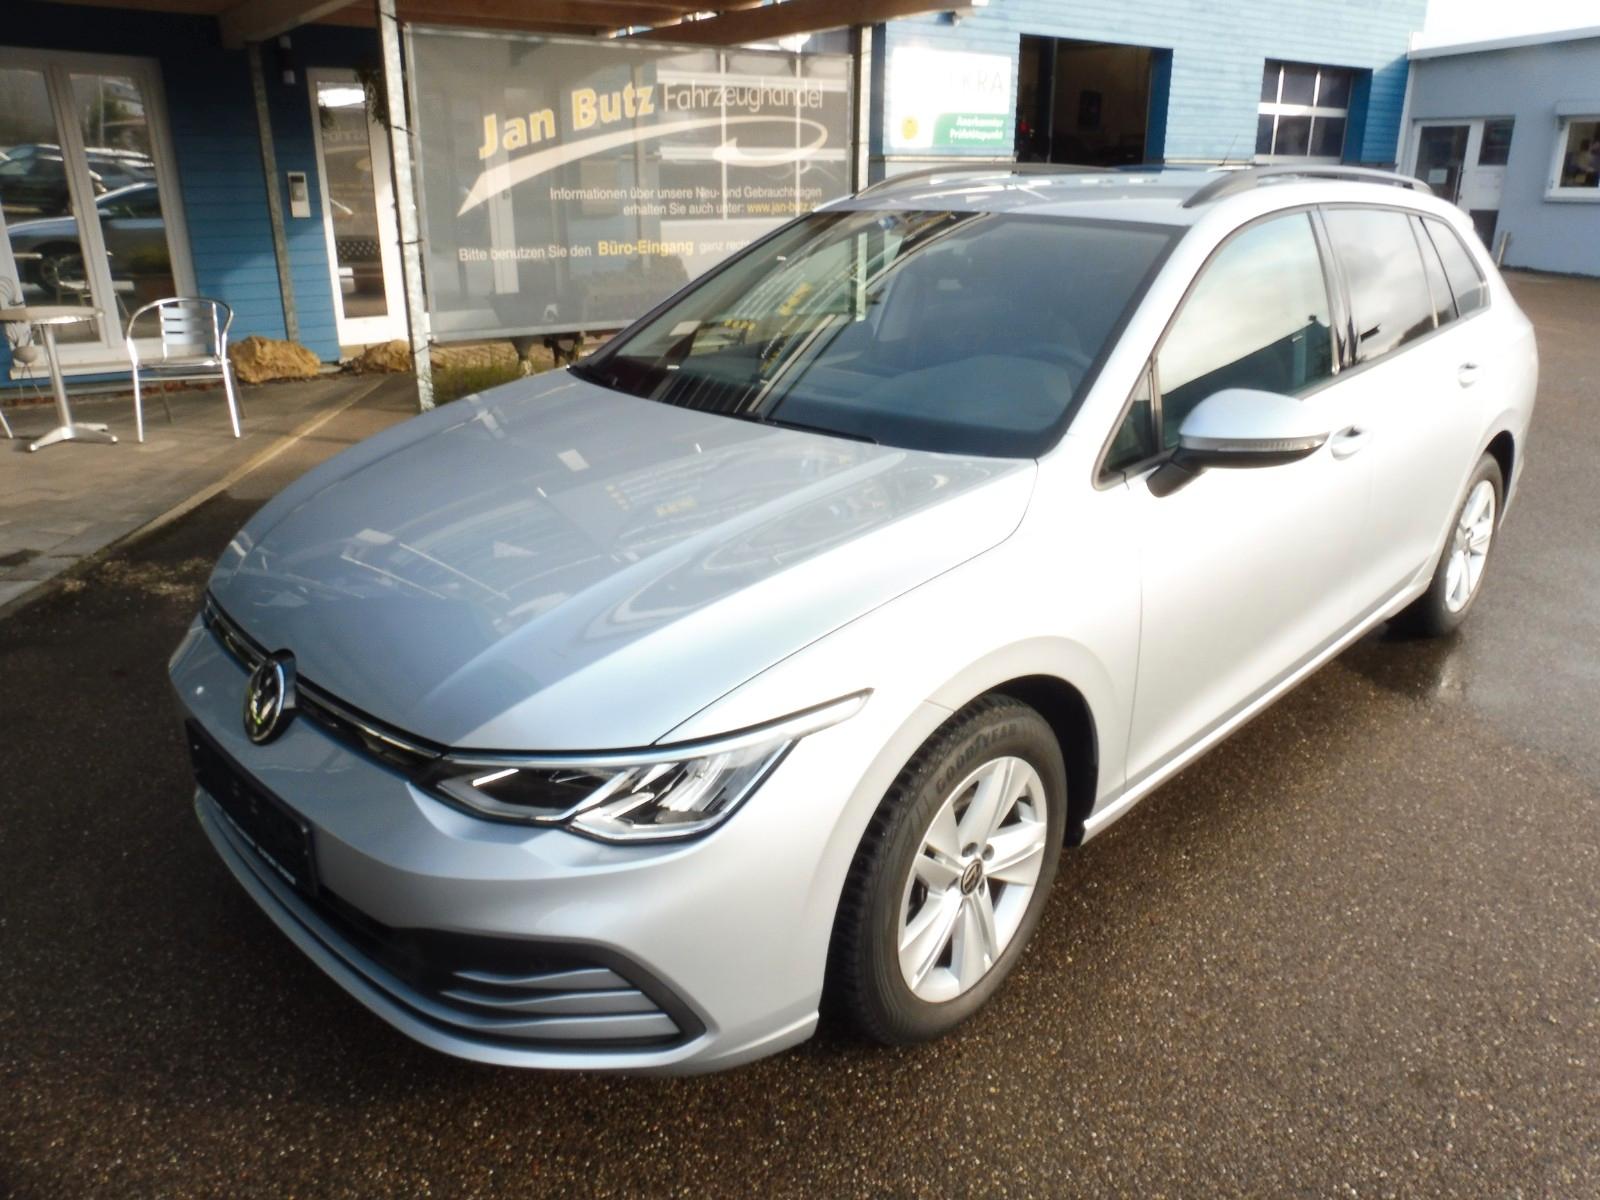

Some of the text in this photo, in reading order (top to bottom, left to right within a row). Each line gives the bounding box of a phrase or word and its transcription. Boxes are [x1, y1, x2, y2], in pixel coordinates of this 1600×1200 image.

[479, 77, 823, 160] Jan Butz Fahrzeughandel
[550, 187, 628, 200] Informationen
[630, 186, 655, 199] über
[658, 187, 693, 199] unsere
[722, 186, 742, 198] nd
[623, 203, 667, 216] erhalten
[669, 202, 687, 215] Sie
[689, 202, 714, 214] auch
[459, 248, 488, 261] Bitte
[490, 247, 545, 260] benutzen
[548, 244, 567, 257] Sie
[570, 244, 592, 257] den
[598, 239, 694, 256] Büro-Eingang
